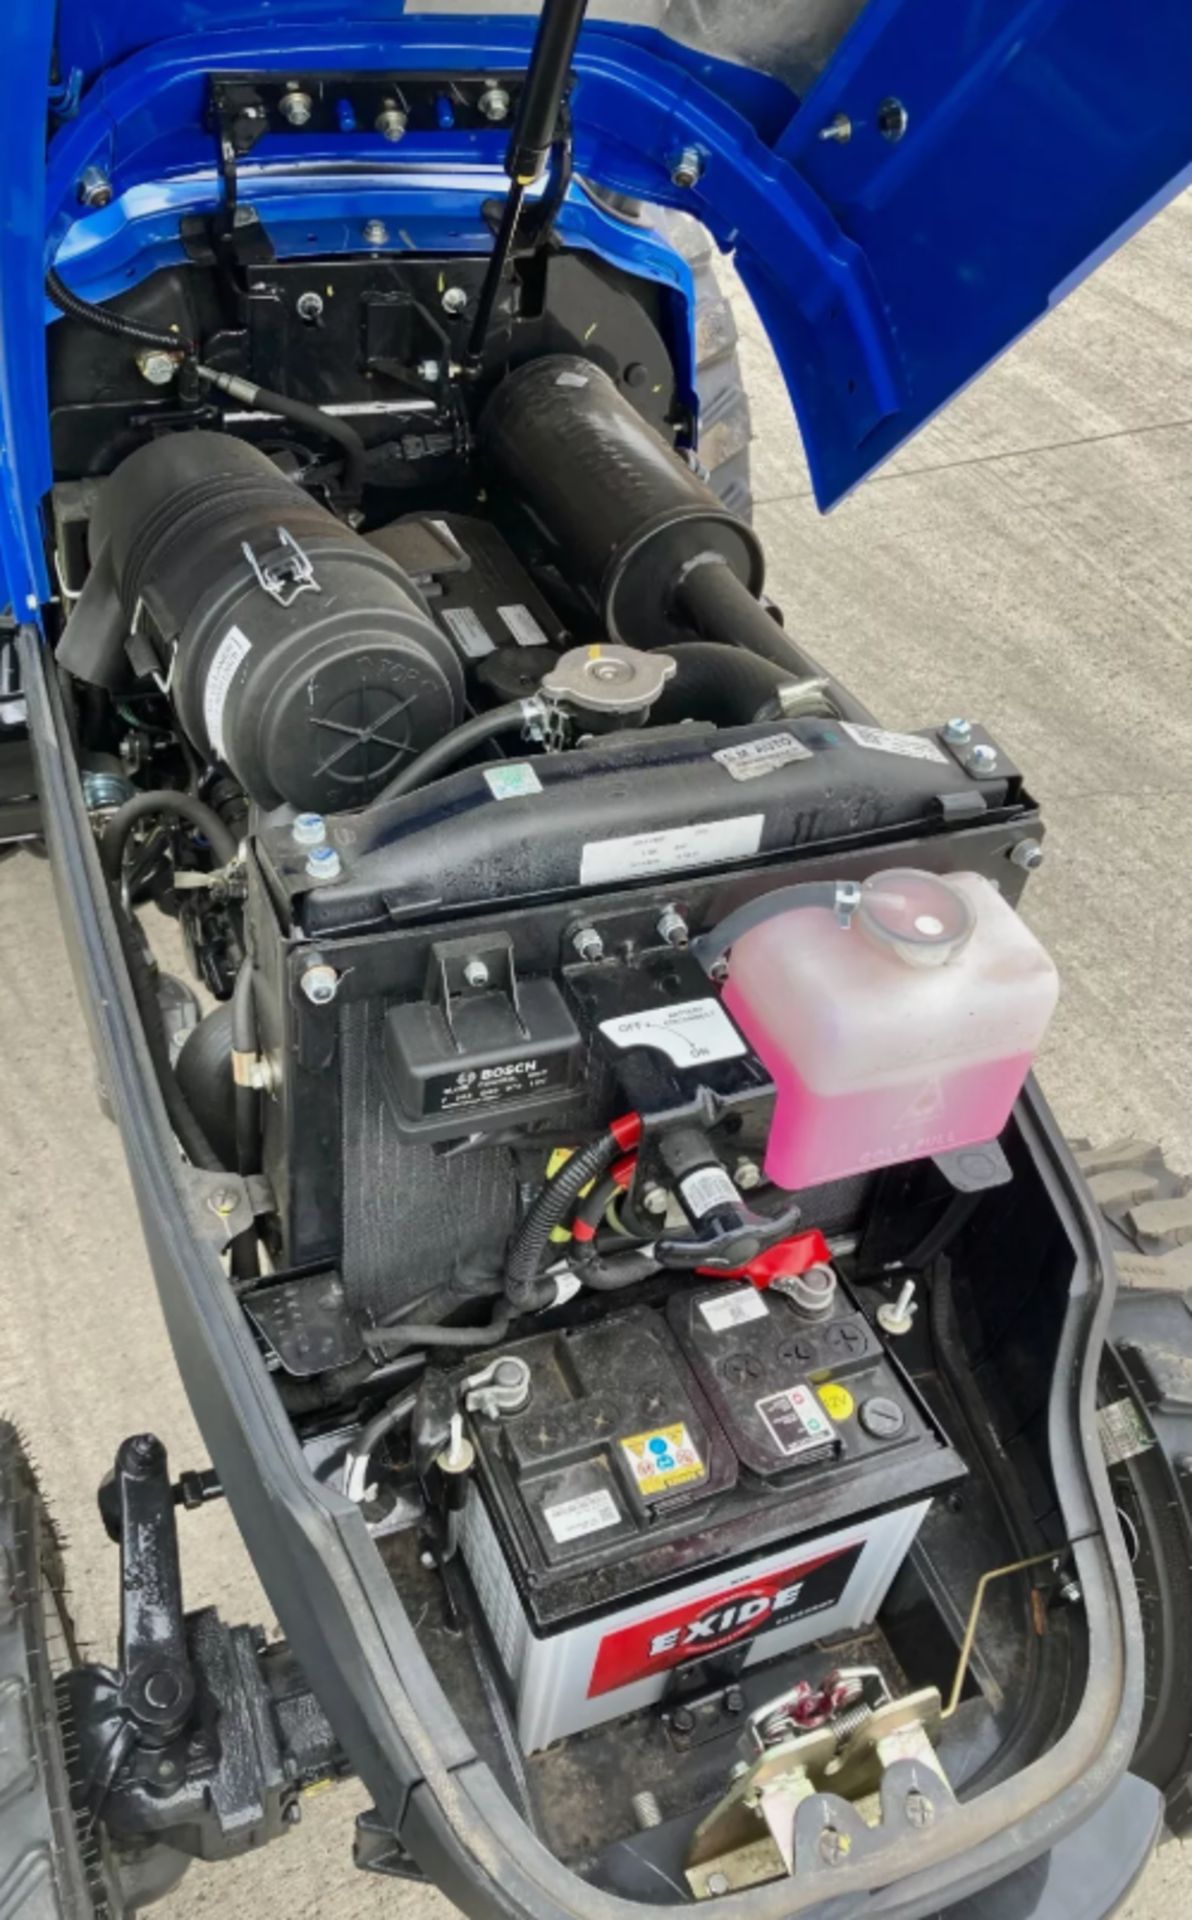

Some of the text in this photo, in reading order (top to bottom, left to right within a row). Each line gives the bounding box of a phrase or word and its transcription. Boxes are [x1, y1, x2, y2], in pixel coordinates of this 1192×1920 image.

[618, 1021, 641, 1033] OFF
[481, 1060, 538, 1080] BOSCH
[650, 1581, 805, 1656] EXIDE
